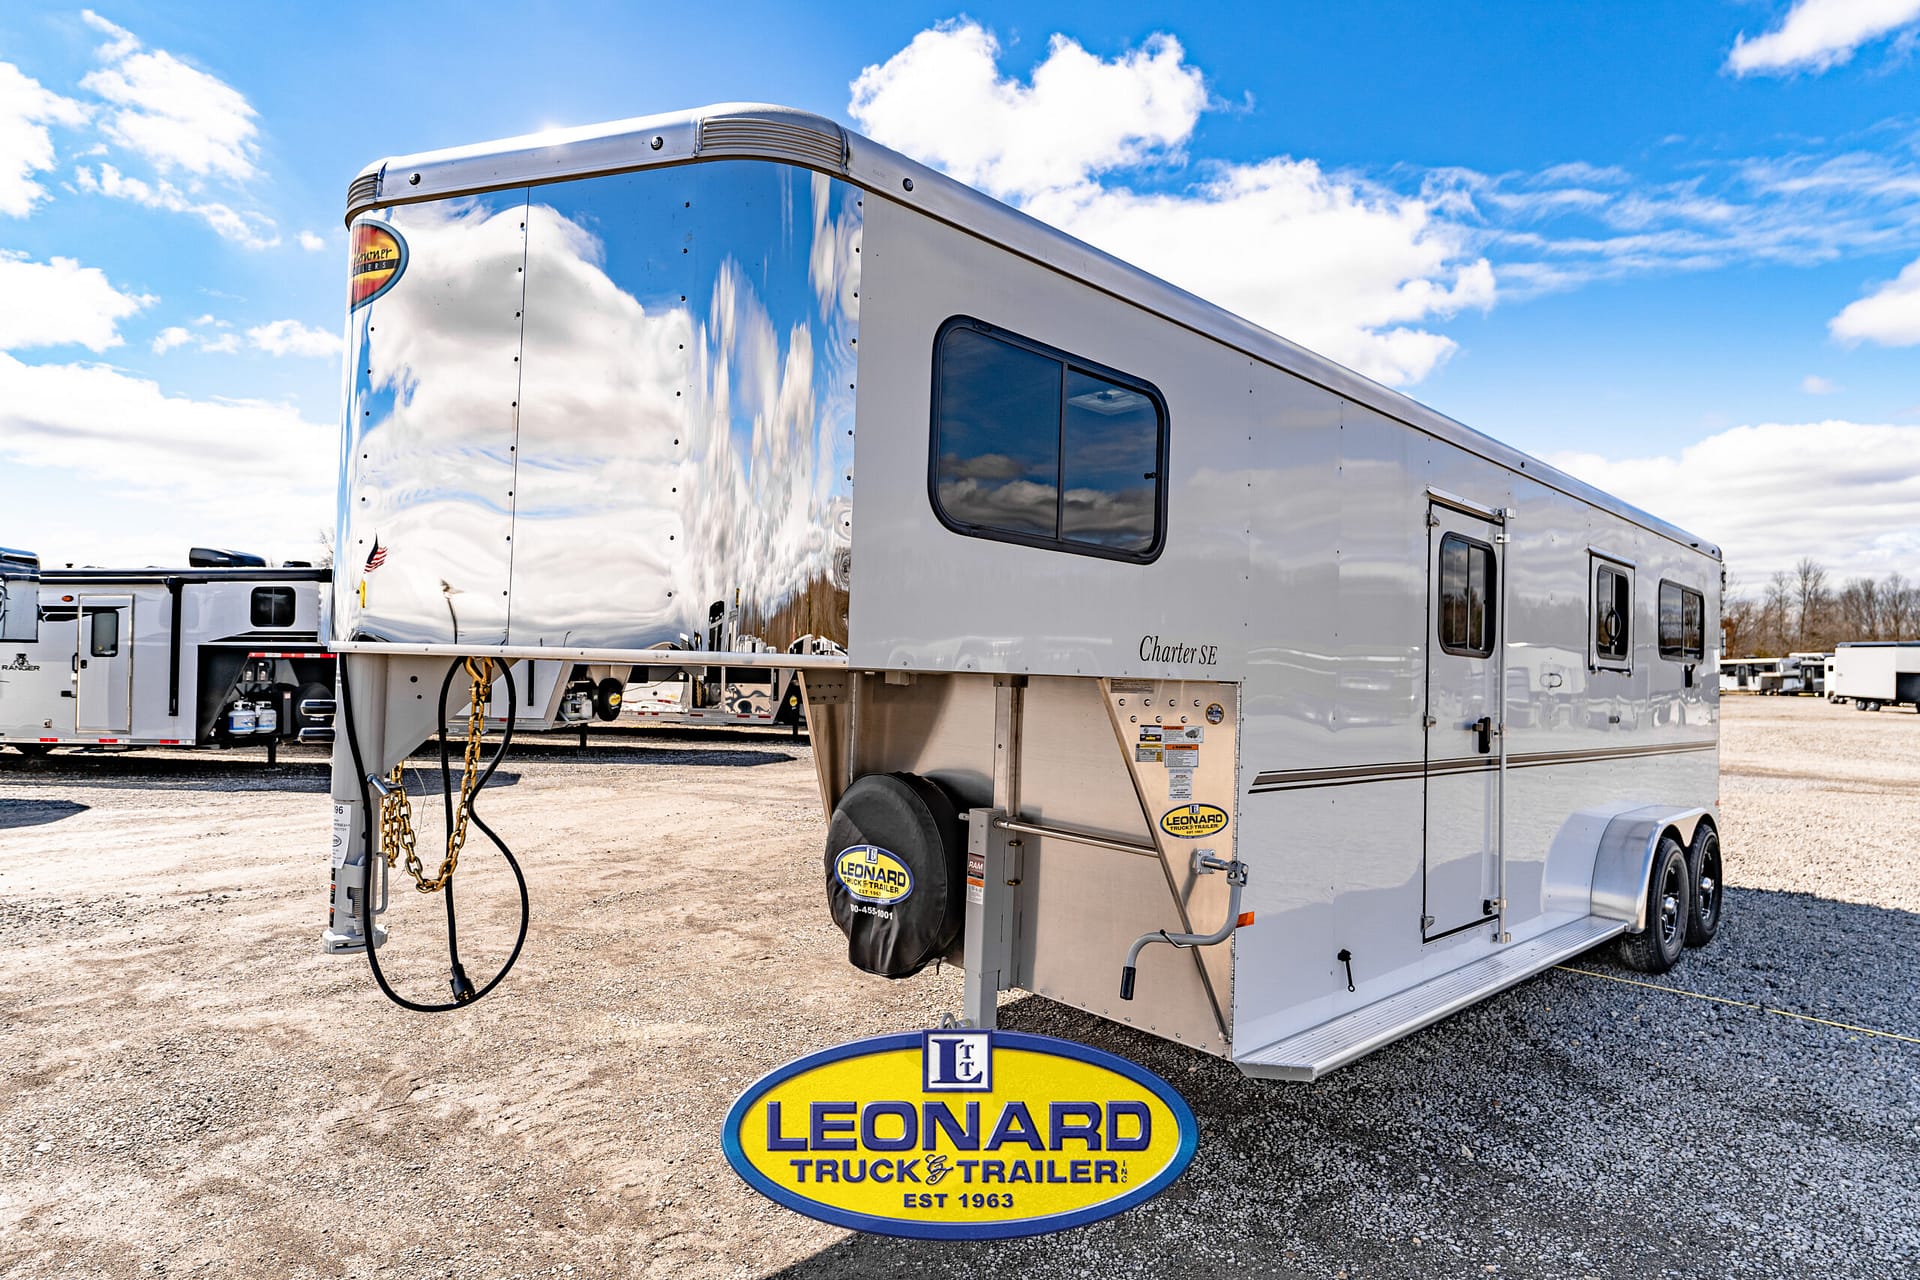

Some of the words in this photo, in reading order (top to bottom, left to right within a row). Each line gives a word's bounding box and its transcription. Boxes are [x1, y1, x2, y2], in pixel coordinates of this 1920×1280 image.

[1139, 635, 1199, 664] Charter
[1199, 645, 1218, 666] SE
[1166, 814, 1223, 826] LEONARD
[968, 861, 984, 871] RAM
[841, 861, 906, 888] LEONARD
[869, 881, 899, 894] TRAILER
